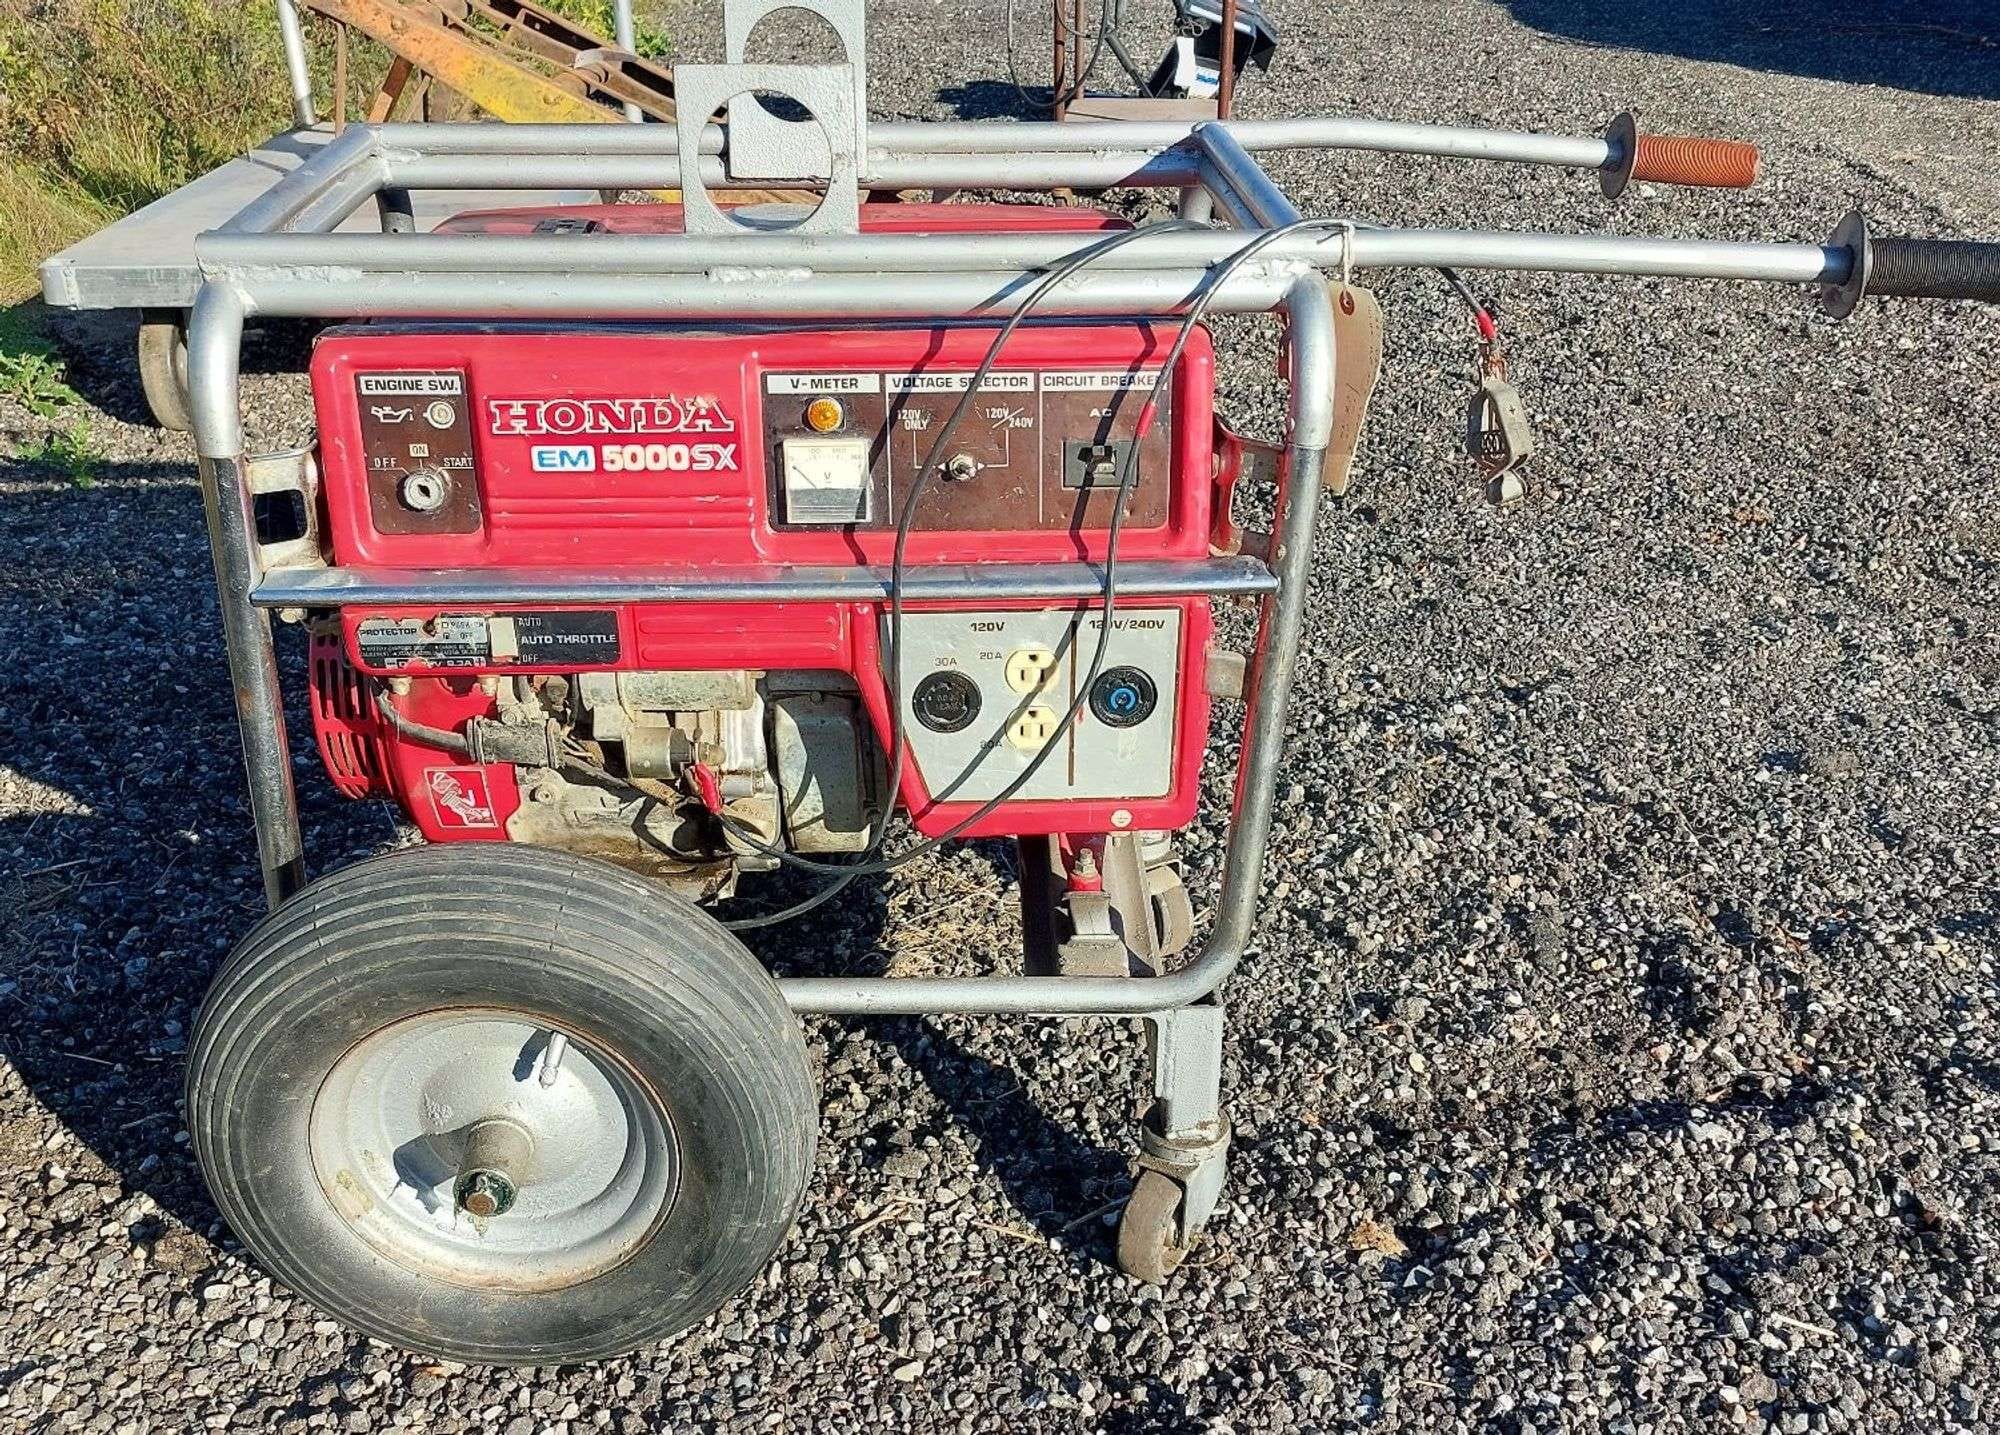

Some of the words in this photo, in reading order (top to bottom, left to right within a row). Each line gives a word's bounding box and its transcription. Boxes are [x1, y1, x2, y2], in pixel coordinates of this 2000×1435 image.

[364, 379, 424, 391] ENGINE
[428, 379, 459, 391] SW.
[790, 377, 859, 390] V-METER
[891, 376, 953, 388] VOLTAGE
[959, 375, 1028, 388] SECTOR
[1043, 375, 1096, 387] CIRCUIT
[1101, 374, 1160, 387] BREAKE
[490, 397, 735, 435] HONDA
[897, 409, 922, 421] 120V
[1089, 408, 1112, 417] AC
[903, 419, 929, 431] ONLY
[411, 445, 427, 455] ON
[373, 457, 398, 468] OFF
[443, 457, 473, 467] START
[537, 449, 590, 468] EM
[601, 443, 739, 472] 5000SX
[518, 617, 542, 627] AUTO
[970, 621, 1006, 633] 120V
[360, 627, 417, 637] PROTECTOR
[521, 635, 553, 645] AUTO
[556, 634, 618, 644] THROTTLE
[522, 653, 539, 663] OFF
[934, 657, 958, 667] 30A
